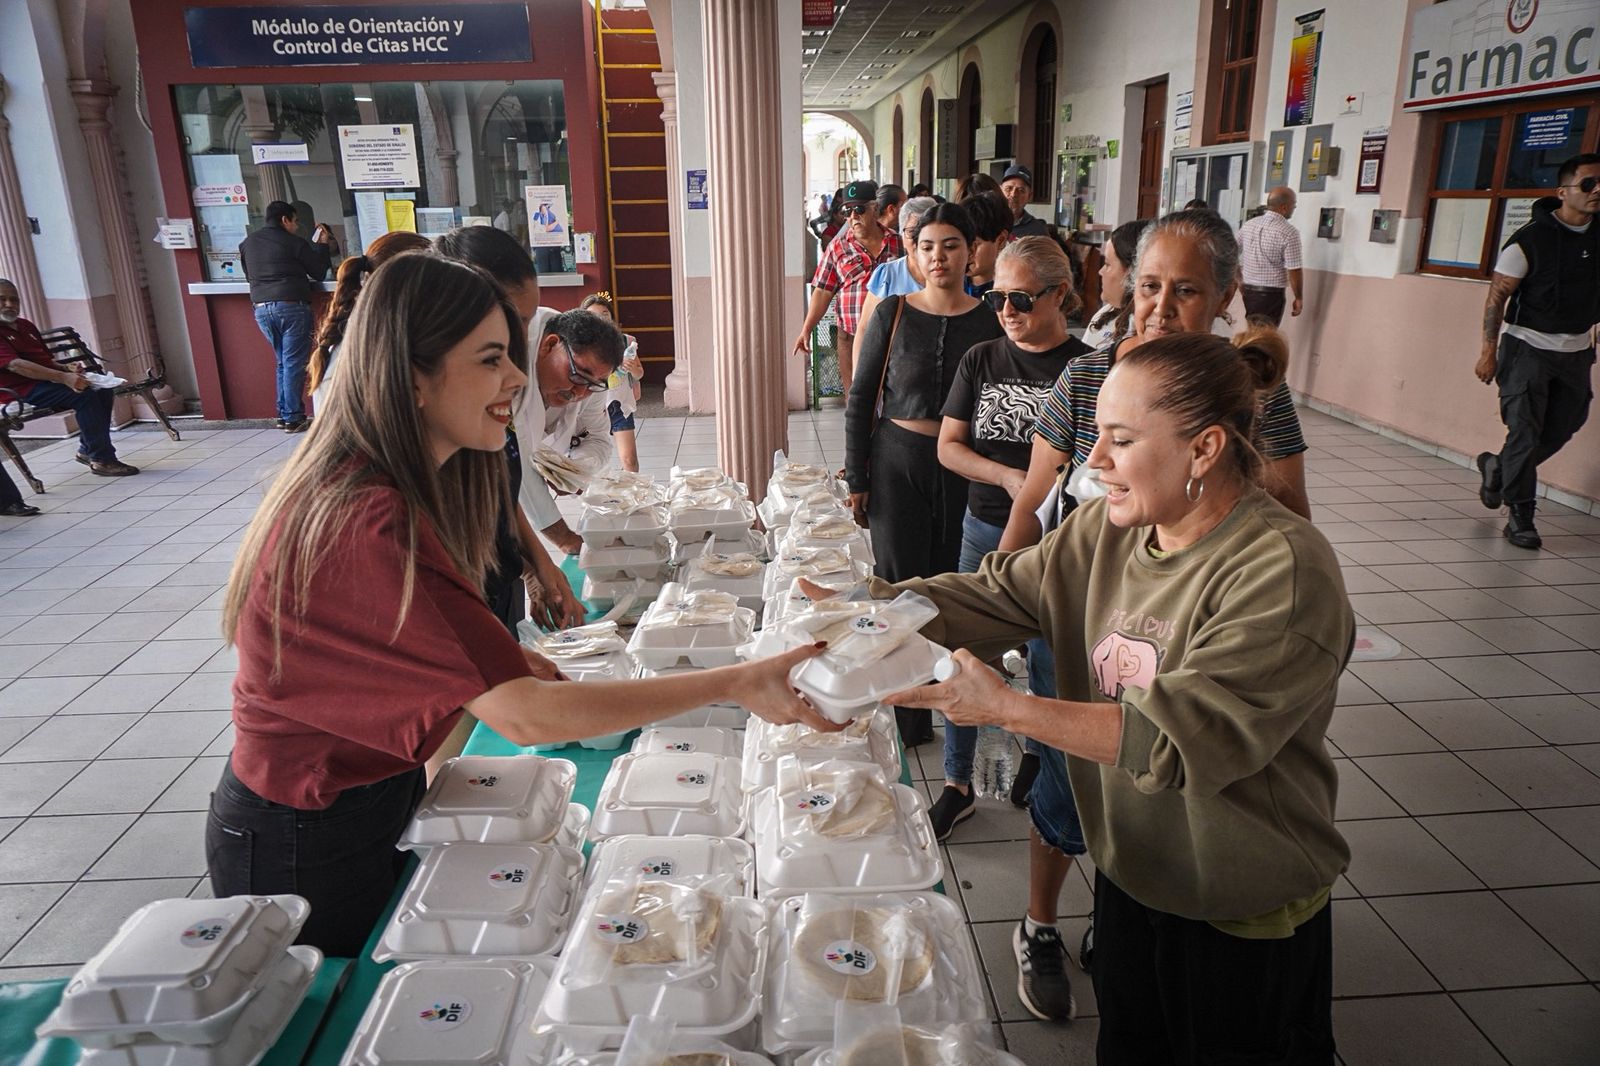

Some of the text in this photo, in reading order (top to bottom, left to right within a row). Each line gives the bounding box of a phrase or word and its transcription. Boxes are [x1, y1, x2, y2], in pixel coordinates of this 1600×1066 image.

[251, 16, 464, 36] Módulo de Orientación y
[272, 36, 448, 55] Control de Citas HCC
[1409, 27, 1600, 99] Farmac
[848, 186, 857, 198] C
[485, 776, 497, 787] DIF
[695, 773, 706, 785] DIF
[512, 869, 525, 883] DIF
[660, 862, 671, 876] DIF
[203, 924, 223, 941] DIF
[622, 921, 639, 939] DIF
[853, 949, 866, 969] DIF
[445, 1002, 462, 1022] DIF
